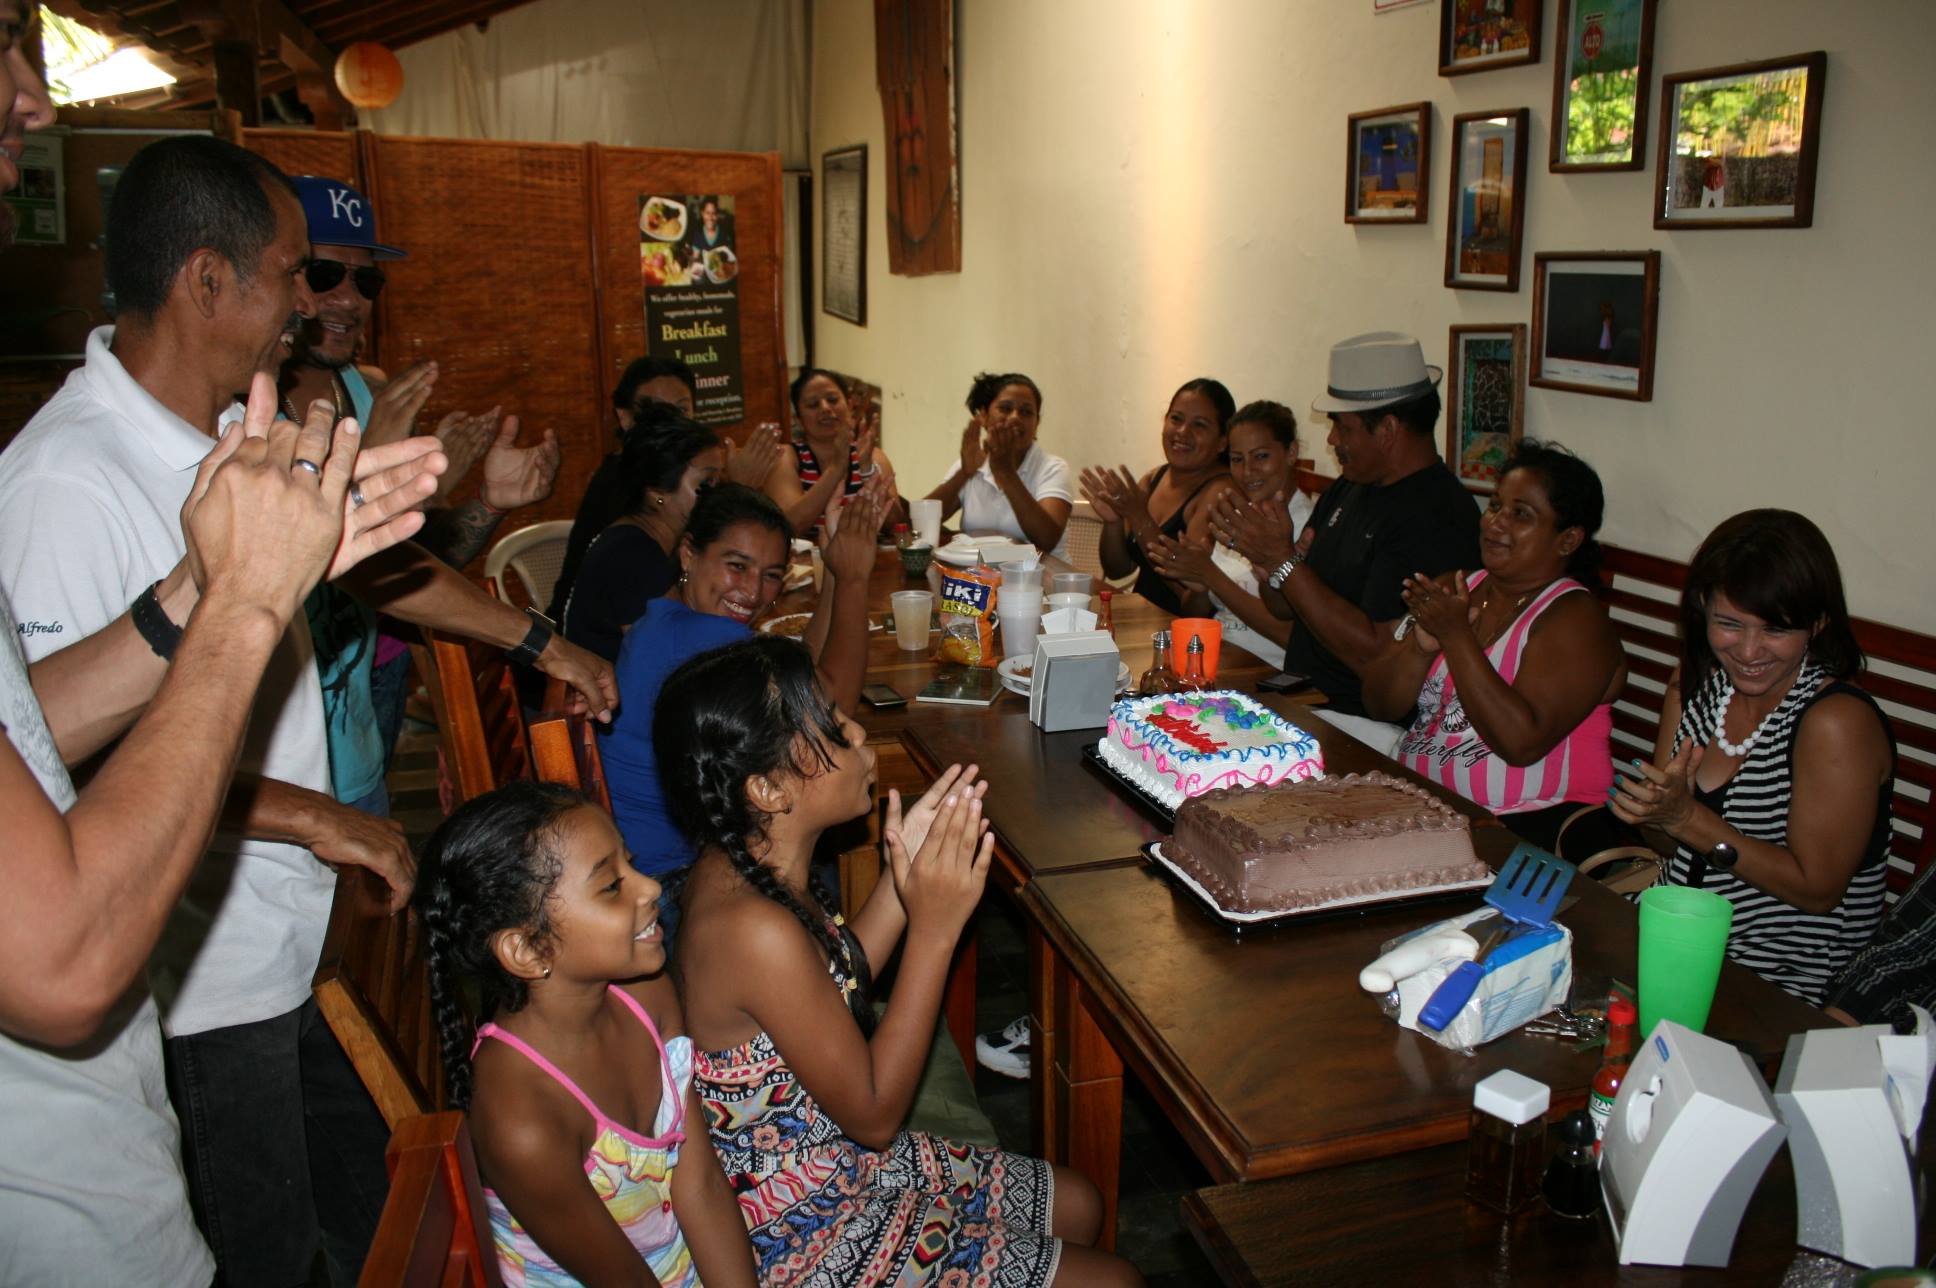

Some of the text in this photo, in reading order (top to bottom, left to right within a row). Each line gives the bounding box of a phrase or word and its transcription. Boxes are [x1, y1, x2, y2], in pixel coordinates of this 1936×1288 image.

[327, 188, 363, 228] KC
[662, 320, 727, 341] Breakfast
[695, 373, 730, 390] inner
[15, 620, 63, 638] Alfredo
